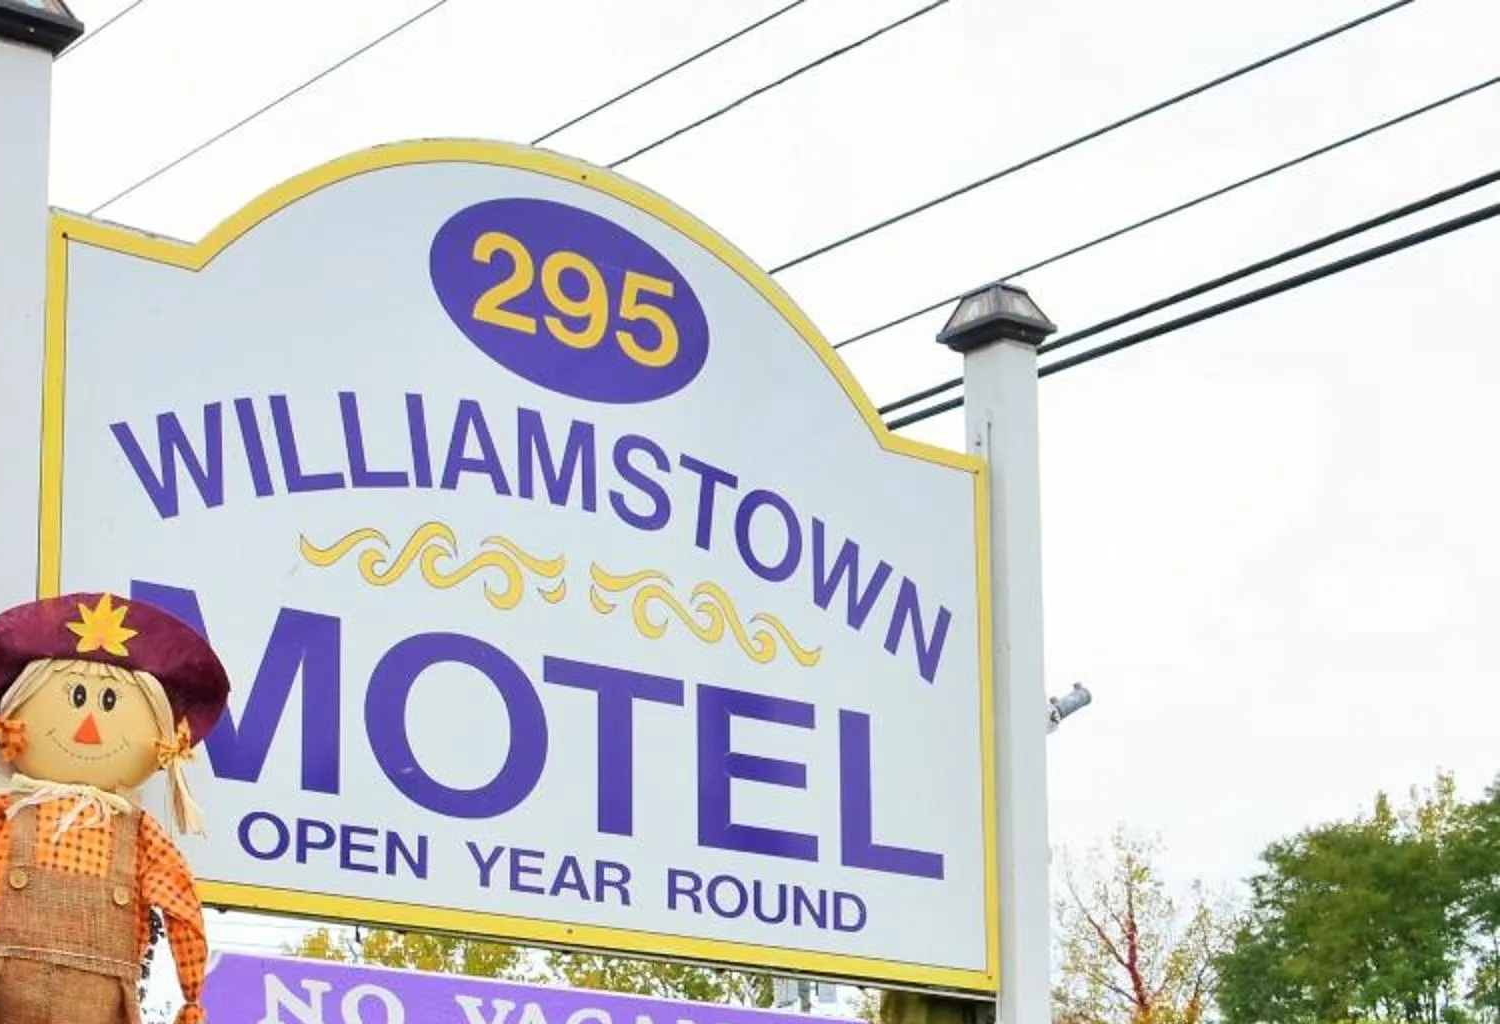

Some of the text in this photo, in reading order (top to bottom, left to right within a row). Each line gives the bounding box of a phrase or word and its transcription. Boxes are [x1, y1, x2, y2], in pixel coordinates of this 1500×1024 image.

[472, 232, 681, 368] 295
[110, 391, 952, 685] WILLIAMSTOWN
[130, 579, 945, 881] MOTEL
[237, 811, 868, 933] OPEN YEAR ROUND
